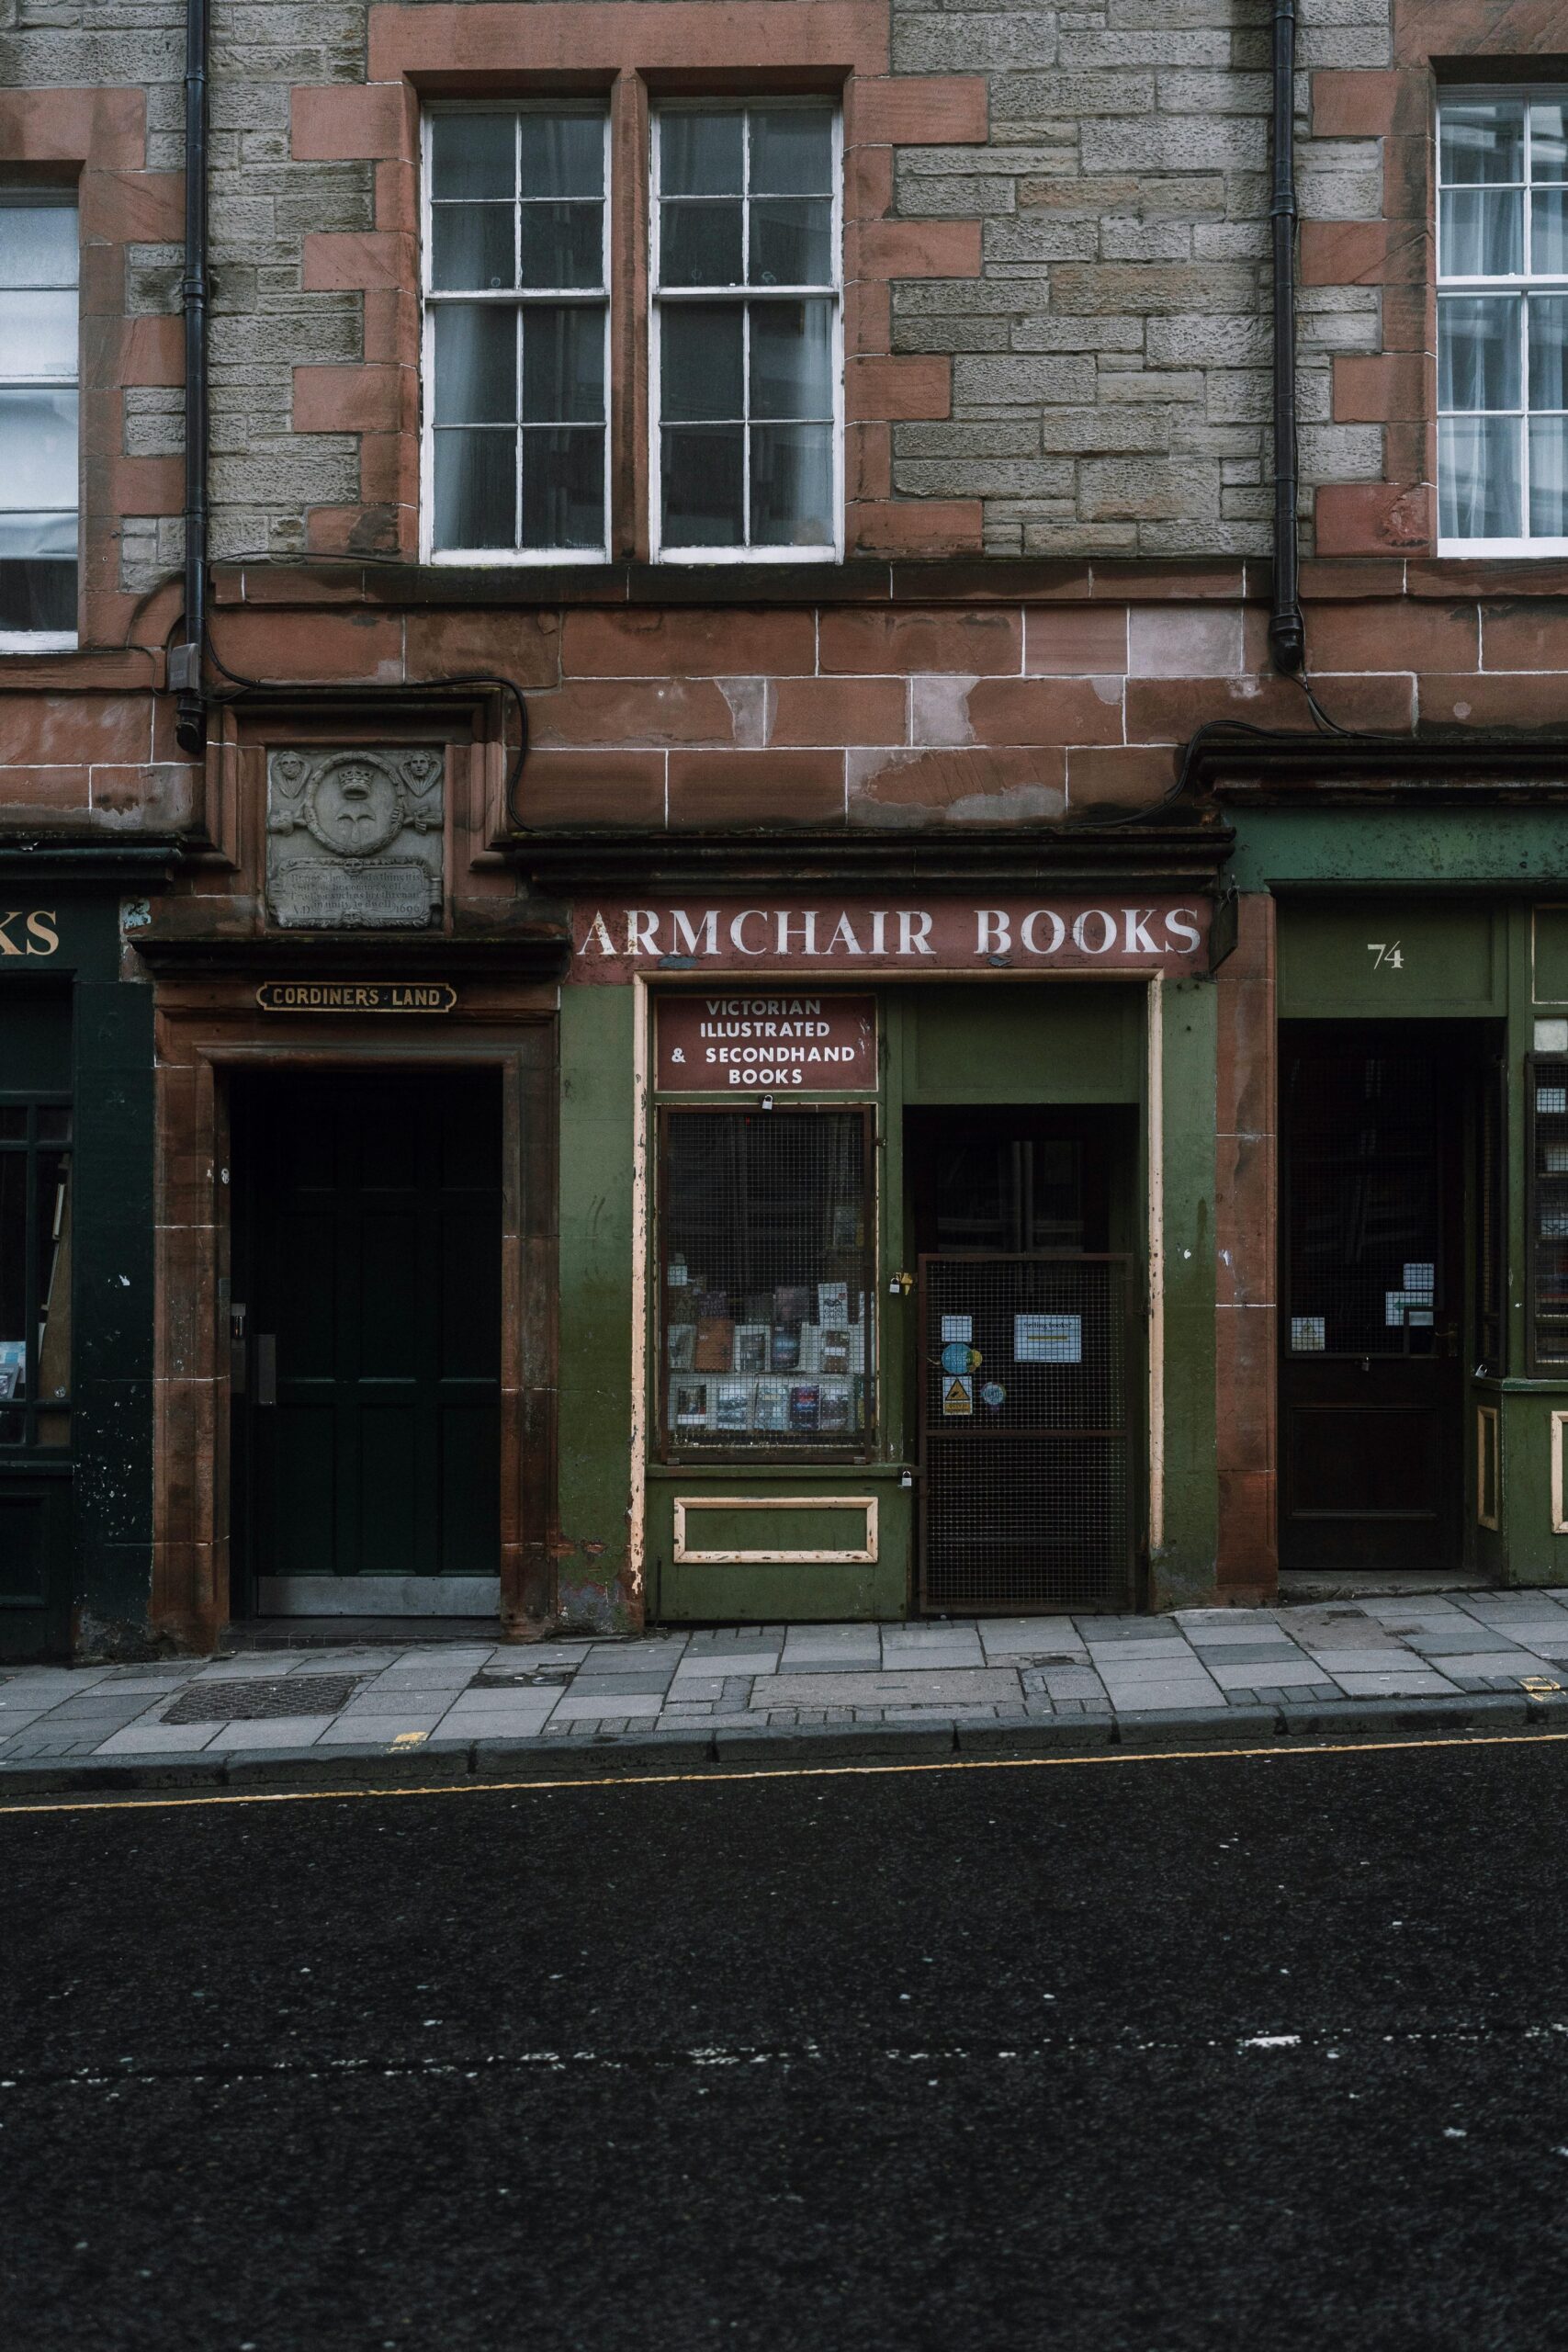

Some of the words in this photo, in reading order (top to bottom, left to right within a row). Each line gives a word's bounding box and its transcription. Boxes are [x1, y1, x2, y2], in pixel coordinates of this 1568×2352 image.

[577, 910, 937, 956] ARMCHAIR
[974, 909, 1201, 955] BOOKS
[1367, 940, 1404, 970] 74
[391, 989, 440, 1006] LAND
[706, 1000, 821, 1016] VICTORIAN
[700, 1022, 830, 1038] ILLUSTRATED
[671, 1047, 686, 1063] &
[705, 1046, 855, 1063] SECONDHAND
[728, 1069, 803, 1084] BOOKS
